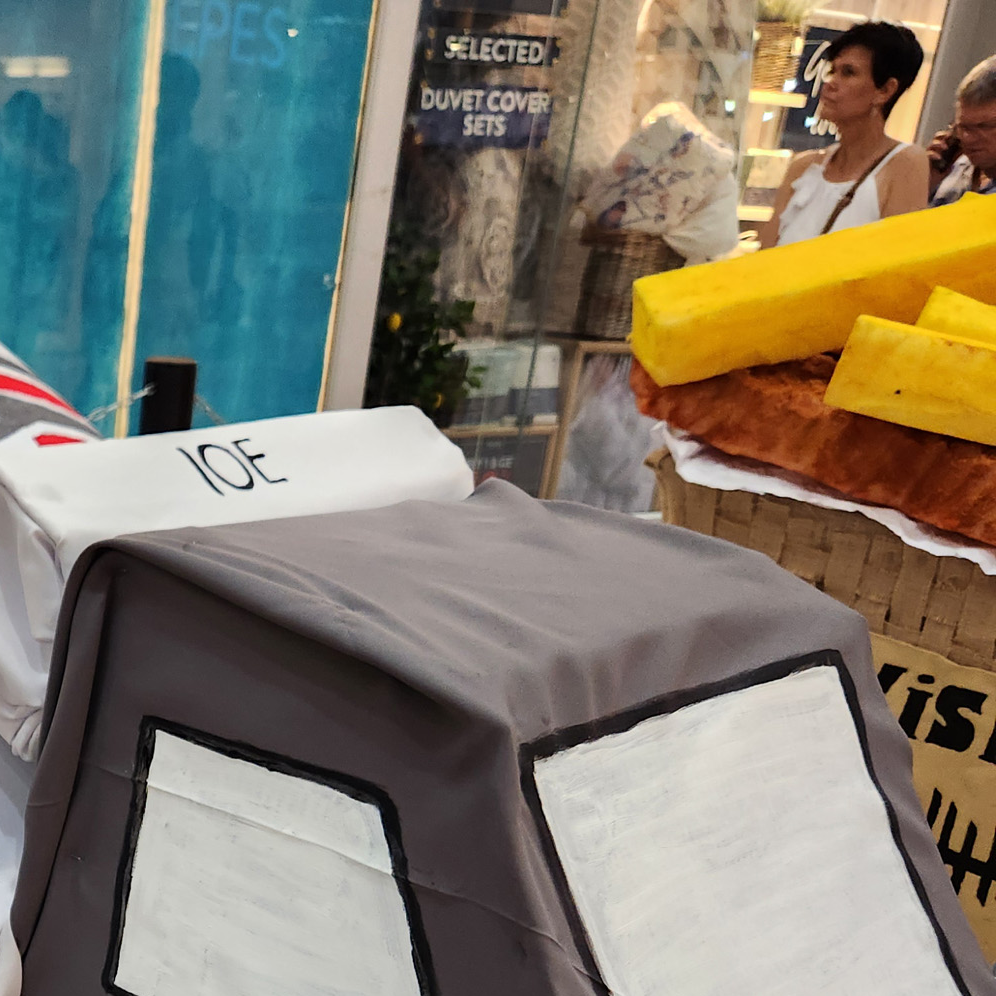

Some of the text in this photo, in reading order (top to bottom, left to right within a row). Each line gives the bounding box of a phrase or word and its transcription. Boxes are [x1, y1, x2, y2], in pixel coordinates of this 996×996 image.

[444, 35, 545, 65] SELECTED
[421, 88, 551, 114] DUVET COVER
[462, 113, 507, 137] SETS
